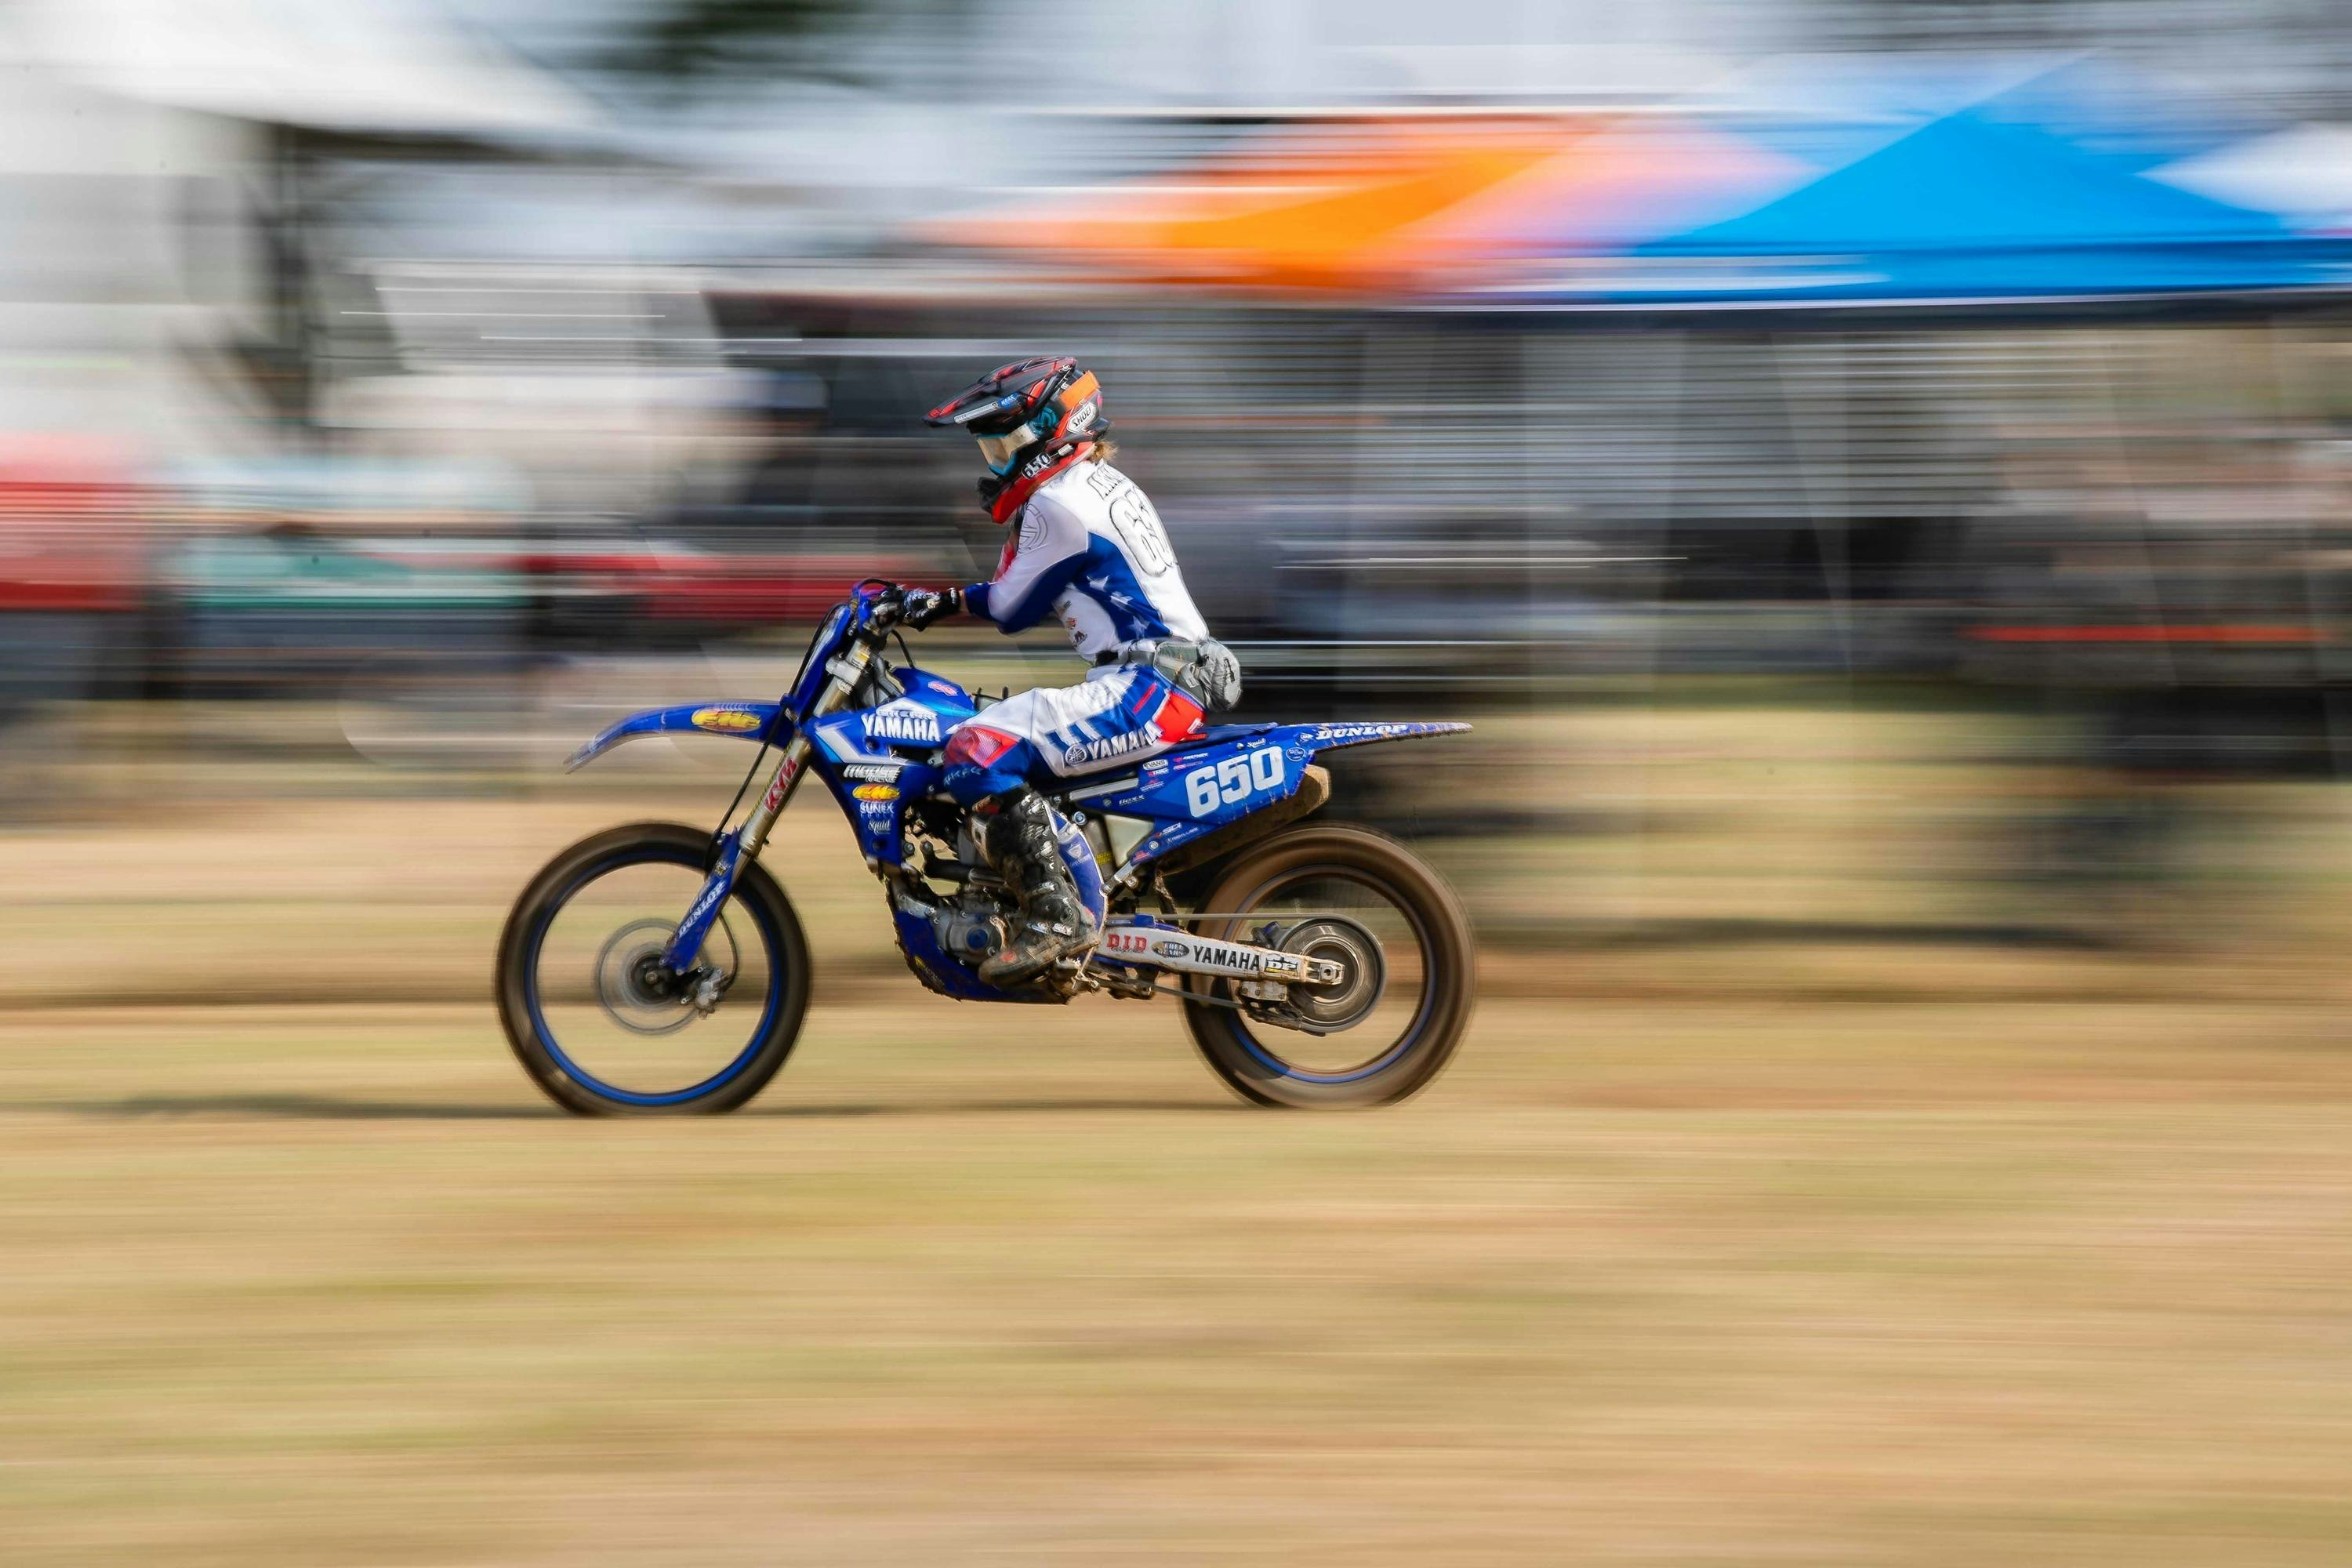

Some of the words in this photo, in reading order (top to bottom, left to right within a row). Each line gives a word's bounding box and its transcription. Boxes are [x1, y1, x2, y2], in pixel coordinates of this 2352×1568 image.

[1072, 408, 1092, 426] SHOEI
[1022, 452, 1051, 480] 650
[861, 713, 941, 742] YAMAHA
[1316, 724, 1408, 740] DUNLOP
[764, 757, 797, 813] KYB
[1185, 746, 1284, 818] 650
[678, 880, 727, 938] DUNLOP
[1193, 946, 1260, 971] YAMAHA
